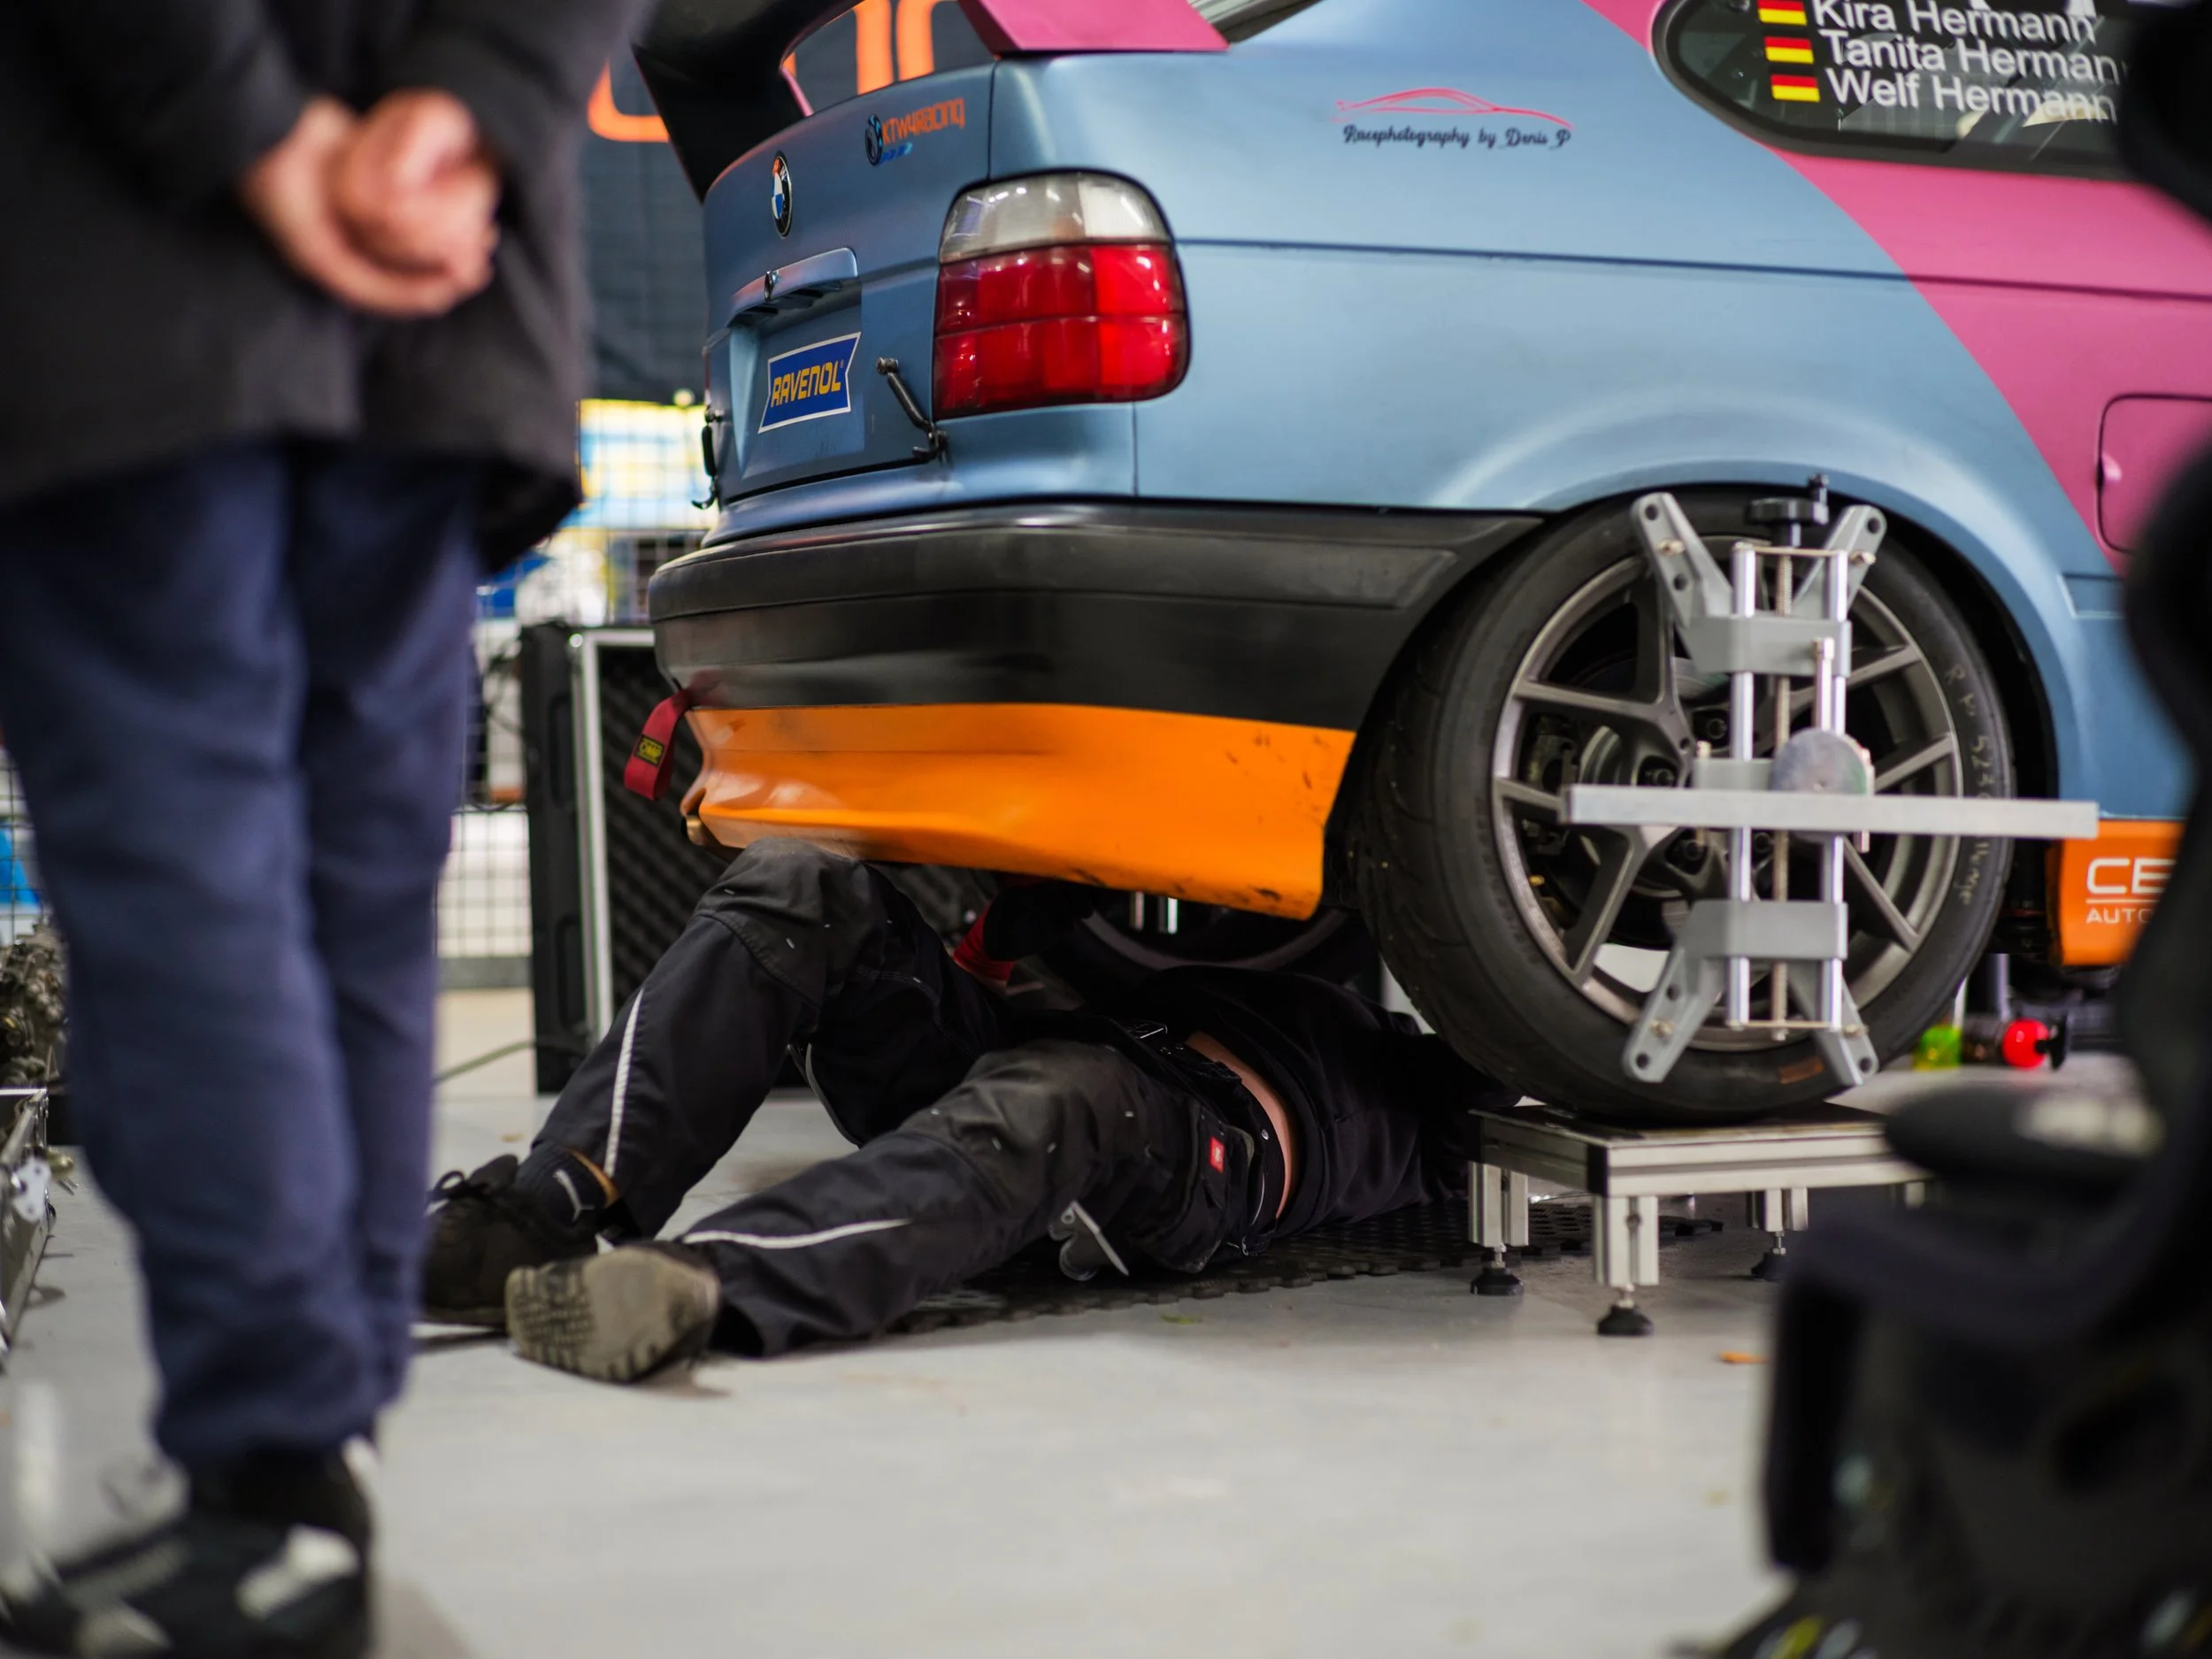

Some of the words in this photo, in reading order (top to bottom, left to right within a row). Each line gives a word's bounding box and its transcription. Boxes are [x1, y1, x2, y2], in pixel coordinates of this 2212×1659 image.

[1813, 0, 1896, 32] Kira
[1907, 0, 2097, 45] Hermann
[1818, 29, 1947, 72] Tanita
[1955, 37, 2127, 86] Herman
[1825, 67, 1920, 109] Welf
[1931, 74, 2117, 126] Hermann
[1343, 124, 1471, 149] Racephotography
[1478, 127, 1496, 149] by
[771, 360, 841, 408] RAVENOL
[2086, 856, 2177, 895] CE
